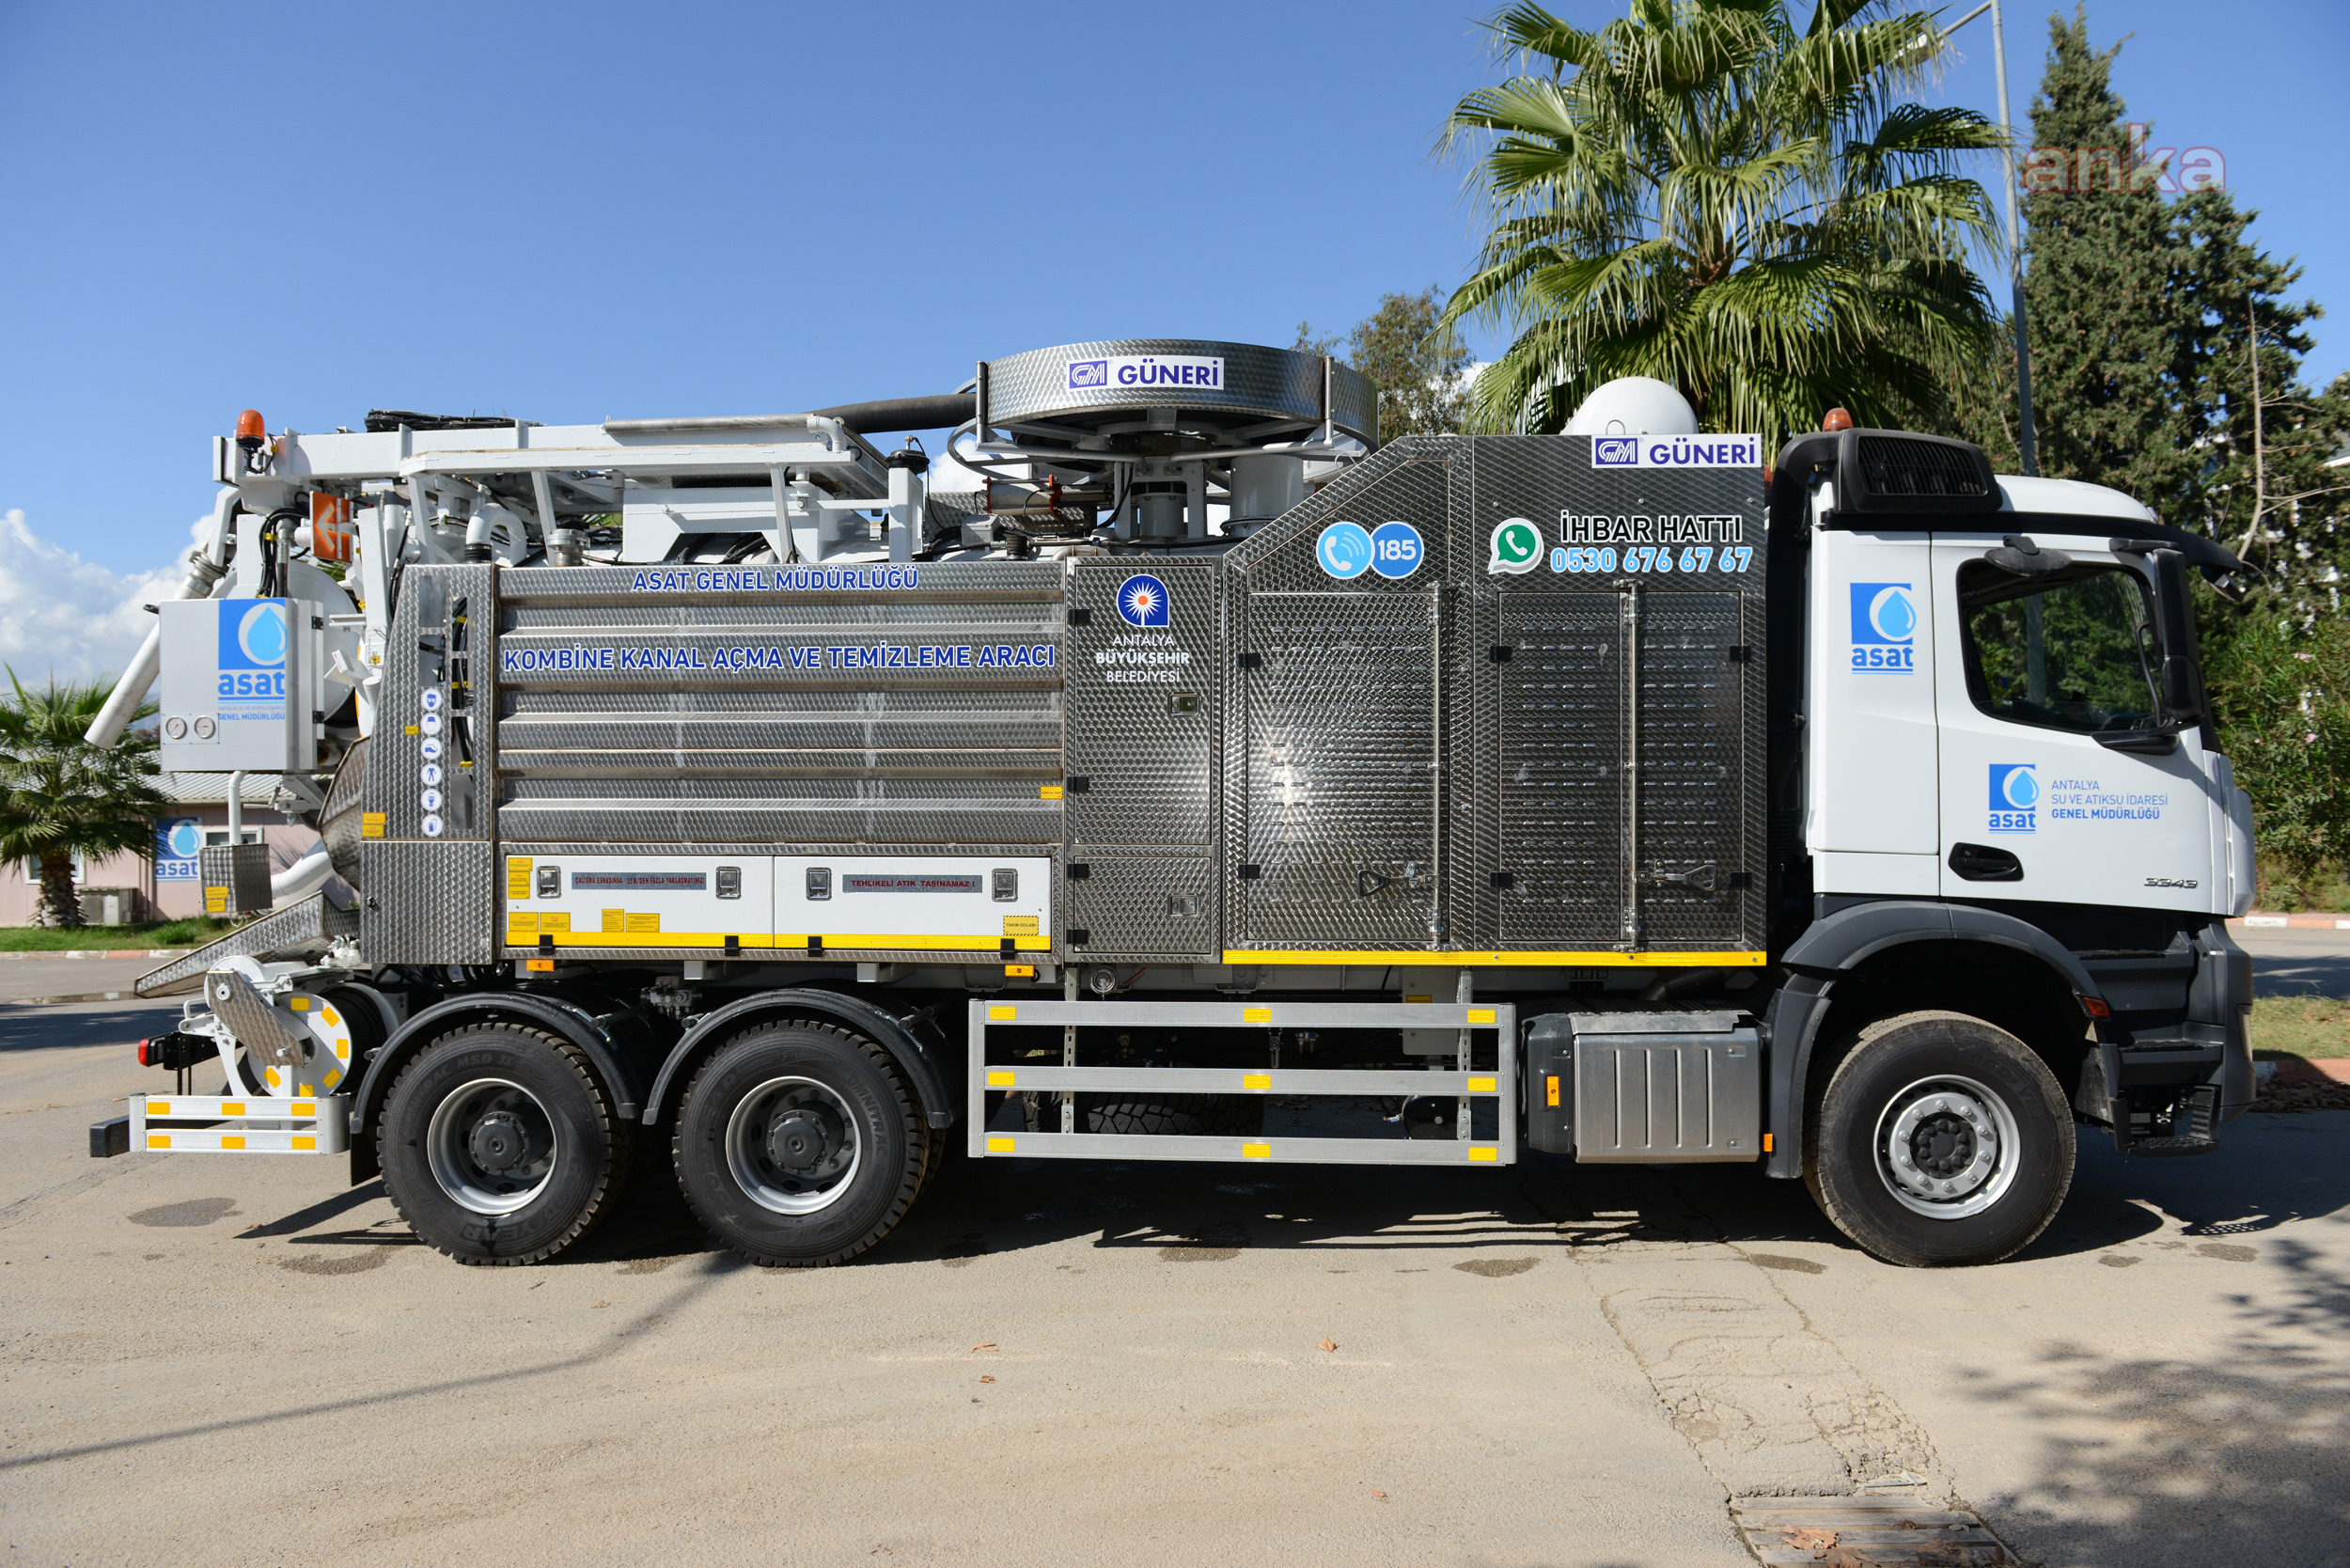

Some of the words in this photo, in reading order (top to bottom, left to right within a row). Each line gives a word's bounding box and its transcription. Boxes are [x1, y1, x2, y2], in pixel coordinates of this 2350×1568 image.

[1118, 358, 1218, 386] GÜNERİ
[1649, 436, 1755, 464] GÜNERİ
[1560, 510, 1653, 542] İHBAR
[1657, 514, 1744, 542] HATTI
[1377, 539, 1417, 560] 185
[1550, 546, 1617, 572] 0530
[1622, 546, 1673, 572] 676
[1678, 546, 1713, 572] 67
[1718, 546, 1753, 572] 67
[633, 572, 690, 590] ASAT
[696, 571, 769, 590] GENEL
[775, 565, 918, 590] MÜDÜRLÜĞÜ
[1112, 635, 1175, 647] ANTALYA
[504, 643, 614, 670] KOMBİNE
[620, 647, 705, 669] KANAL
[712, 647, 783, 673] AÇMA
[790, 647, 821, 667] VE
[827, 640, 971, 667] TEMİZLEME
[977, 645, 1055, 667] ARACI
[1095, 648, 1190, 666] BÜYÜKŞEHİR
[1851, 647, 1914, 666] asat
[217, 671, 285, 695] asat
[1106, 667, 1180, 682] BELEDİYESİ
[242, 712, 286, 720] MÜDÜRLÜĞÜ
[2051, 779, 2100, 791] ANTALYA
[2051, 794, 2068, 805] SU
[2069, 794, 2083, 805] VE
[2085, 794, 2123, 805] ATIKSU
[2126, 792, 2169, 806] İDARESİ
[1988, 812, 2036, 828] asat
[2051, 808, 2089, 819] GENEL
[2091, 807, 2160, 820] MÜDÜRLÜĞÜ
[157, 861, 197, 876] asat
[921, 880, 970, 888] TAŞINAMAZ
[2144, 878, 2198, 888] 3343
